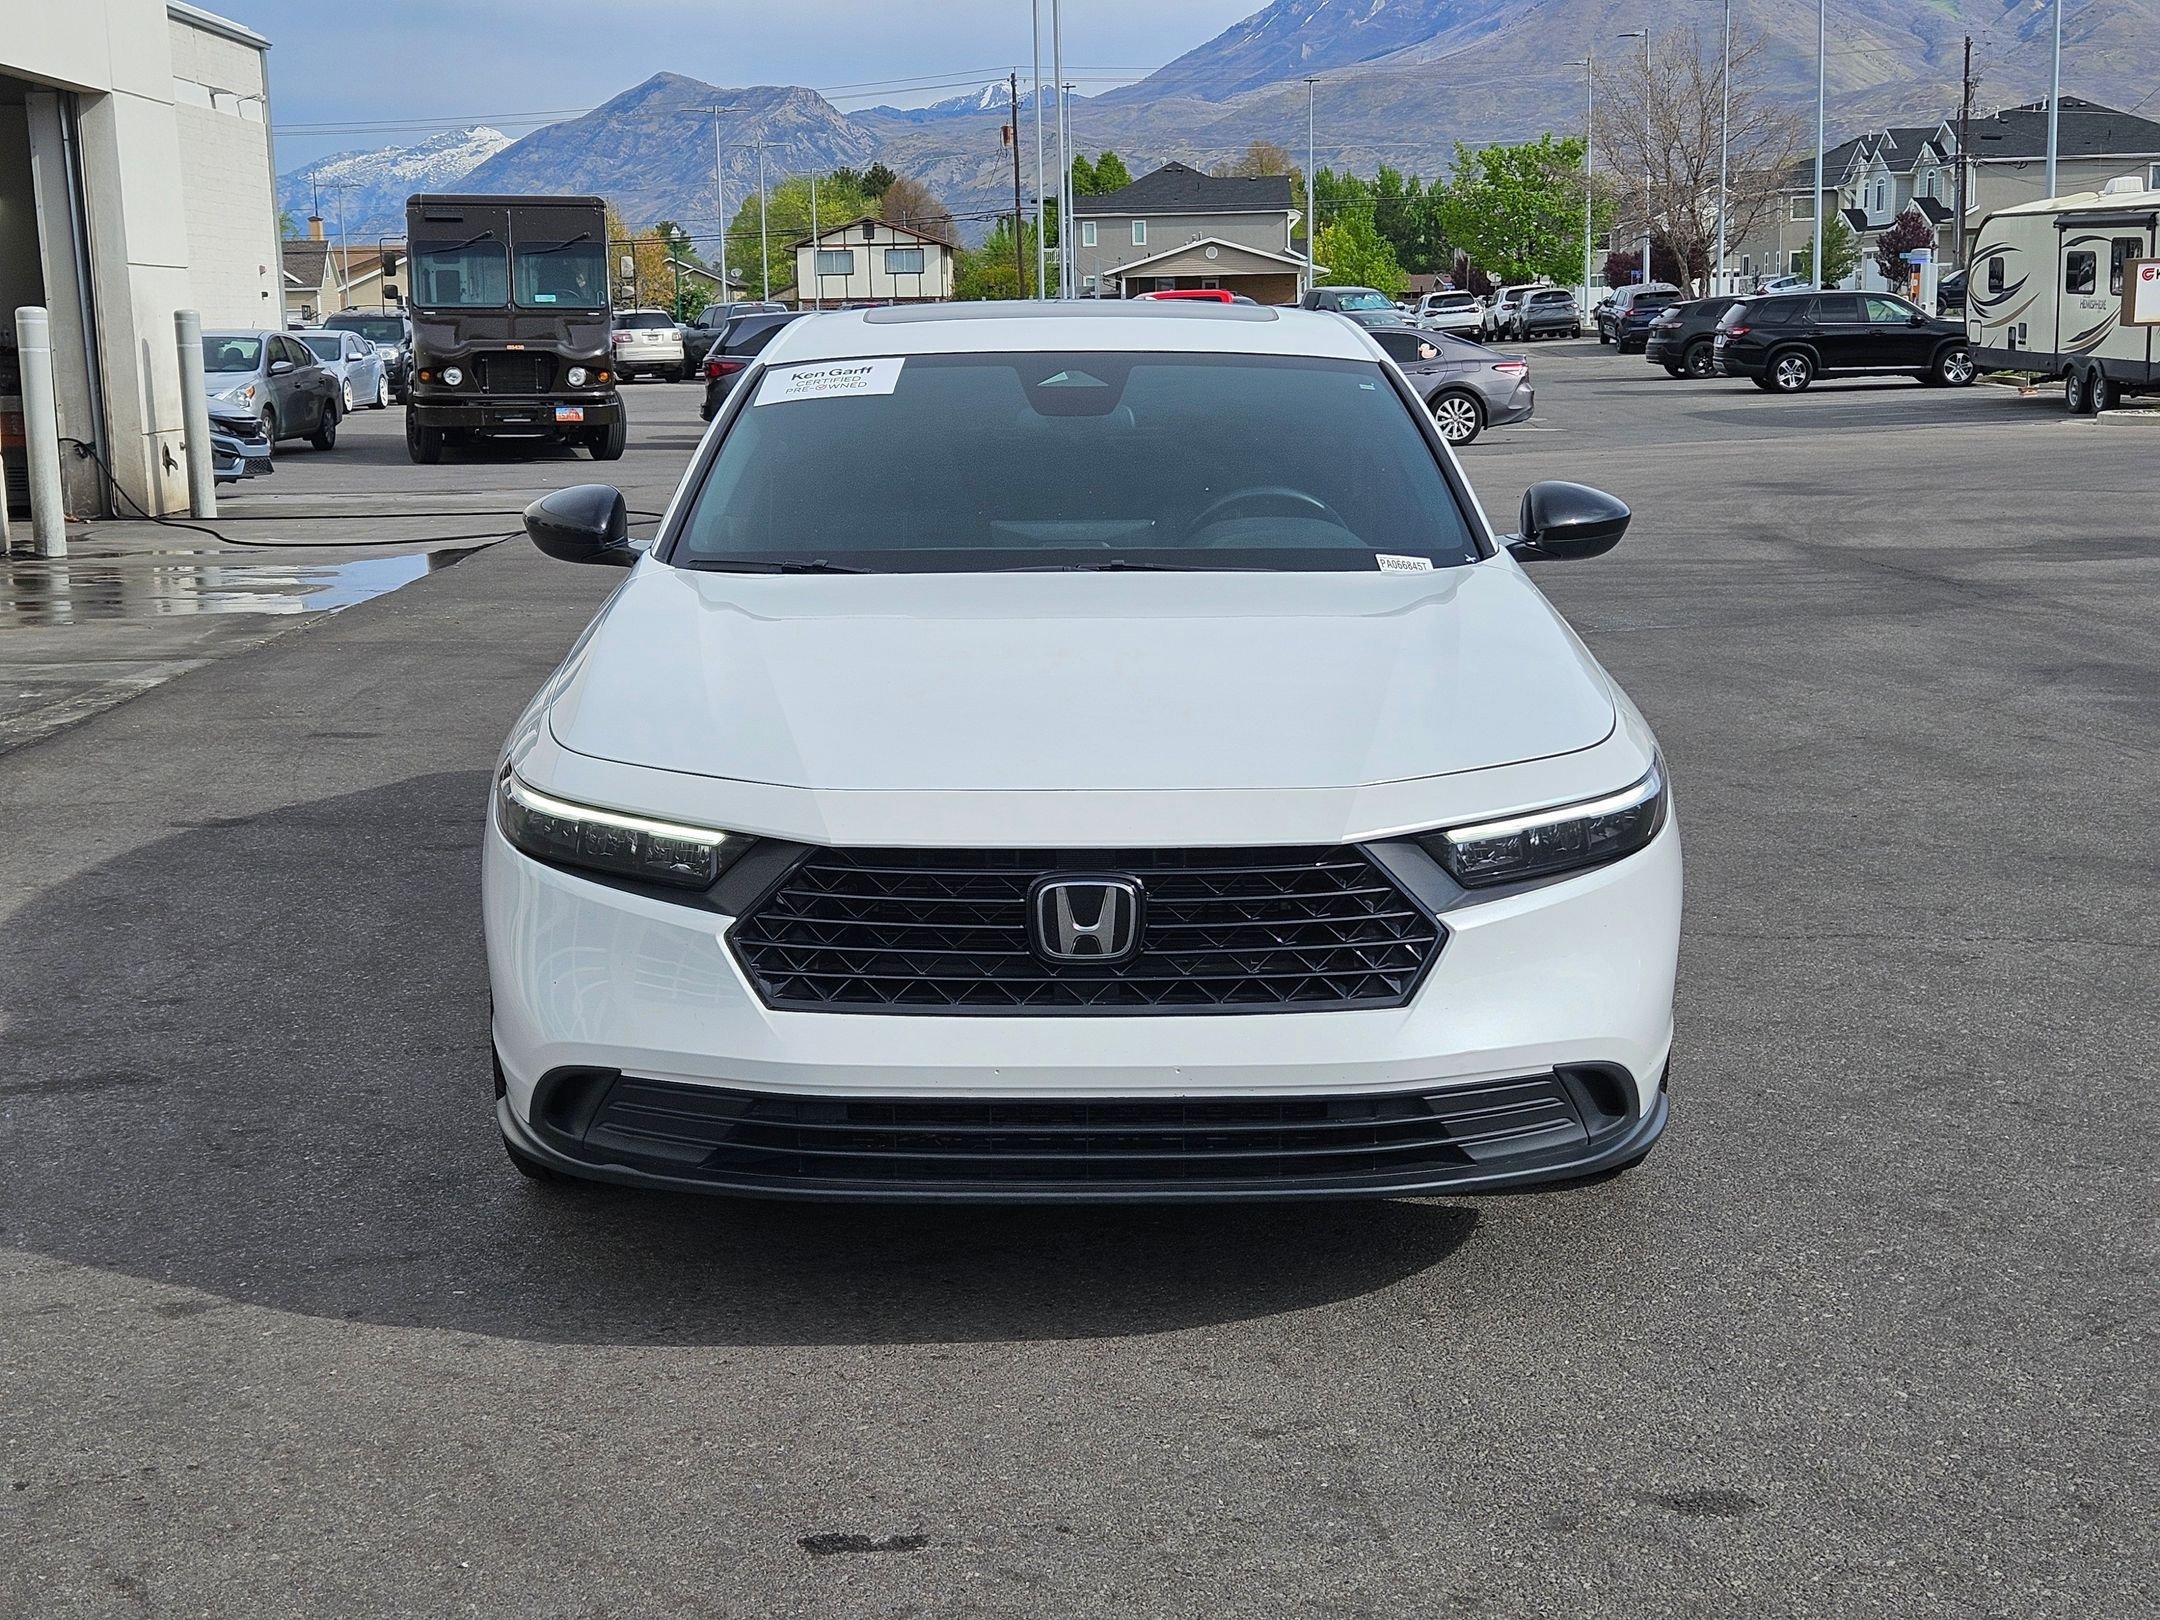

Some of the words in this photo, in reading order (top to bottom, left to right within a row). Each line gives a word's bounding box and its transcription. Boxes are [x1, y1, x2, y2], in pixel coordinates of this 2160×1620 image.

[791, 370, 825, 381] Ken
[829, 366, 873, 376] Garff
[796, 376, 861, 387] CERTIFIED
[785, 382, 867, 394] PRE-OWNED
